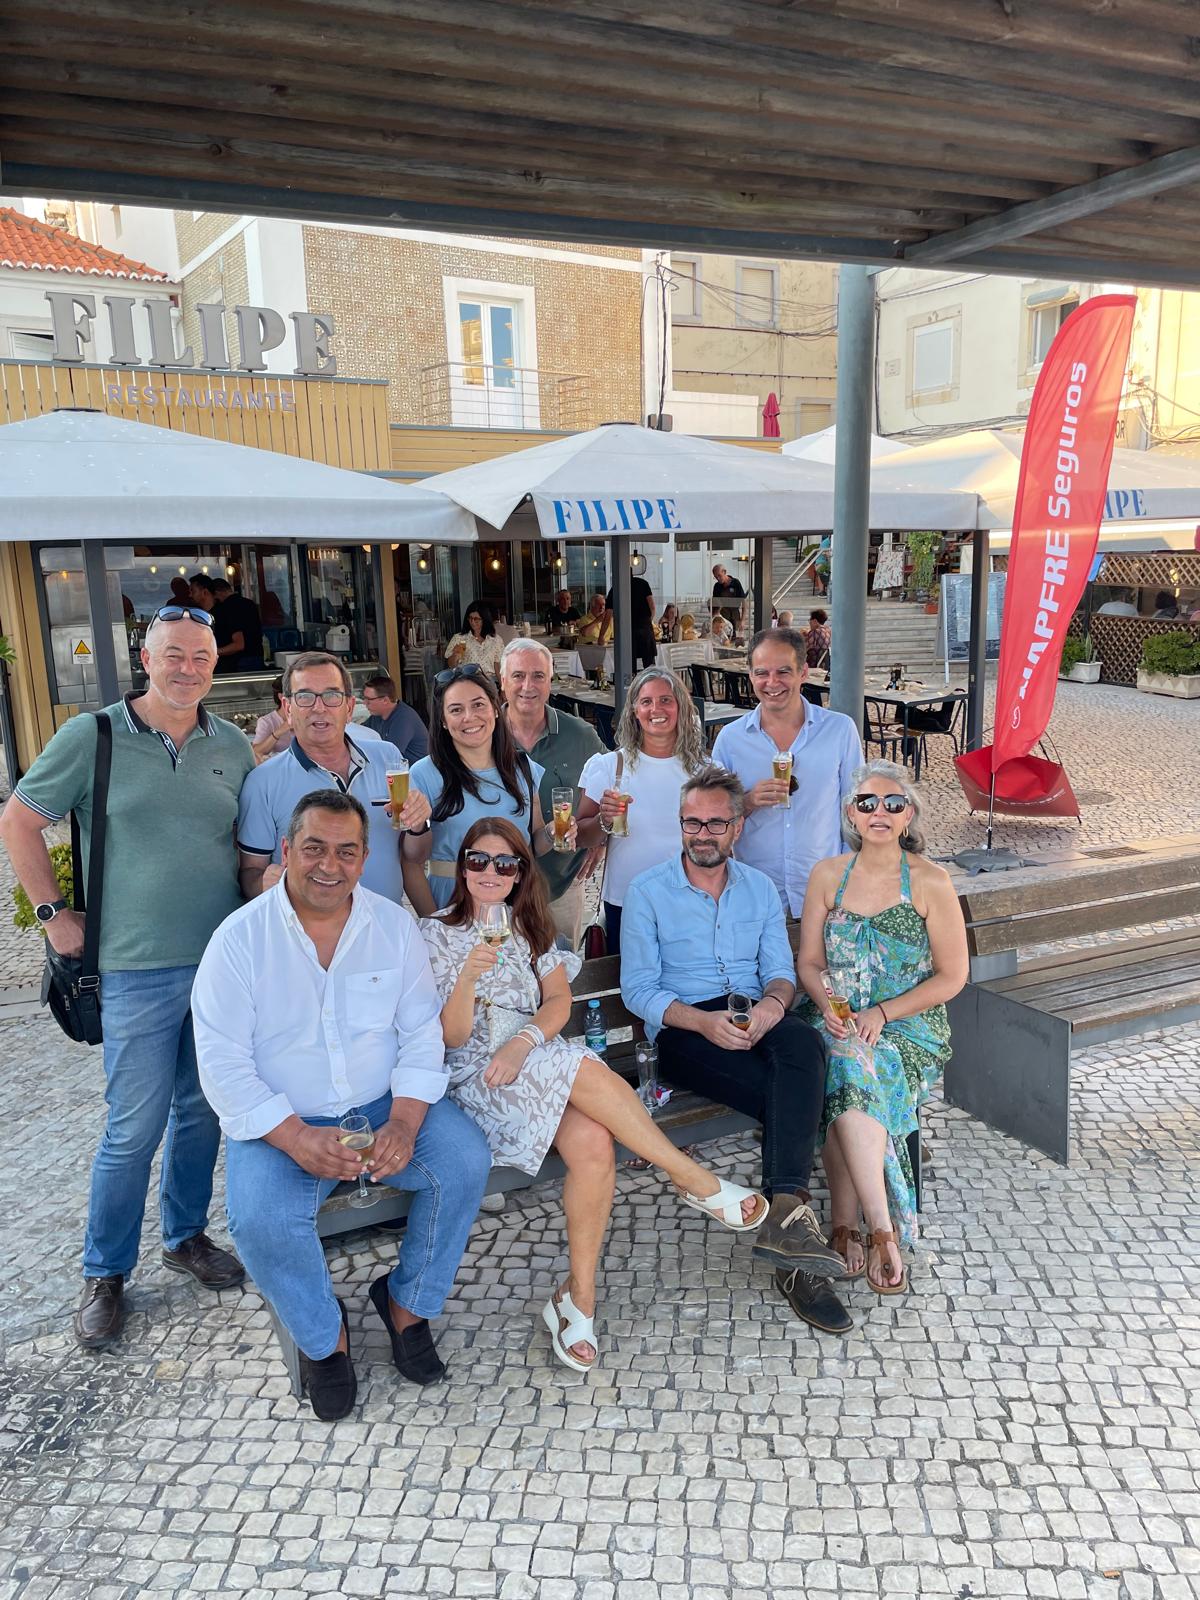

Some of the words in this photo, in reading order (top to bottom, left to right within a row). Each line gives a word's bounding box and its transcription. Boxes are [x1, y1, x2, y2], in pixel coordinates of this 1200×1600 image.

[46, 291, 337, 376] FILIPE
[107, 384, 296, 412] RESTAURANTE
[1048, 361, 1087, 519] Seguros
[552, 498, 682, 534] FILIPE
[1105, 489, 1147, 518] IPE
